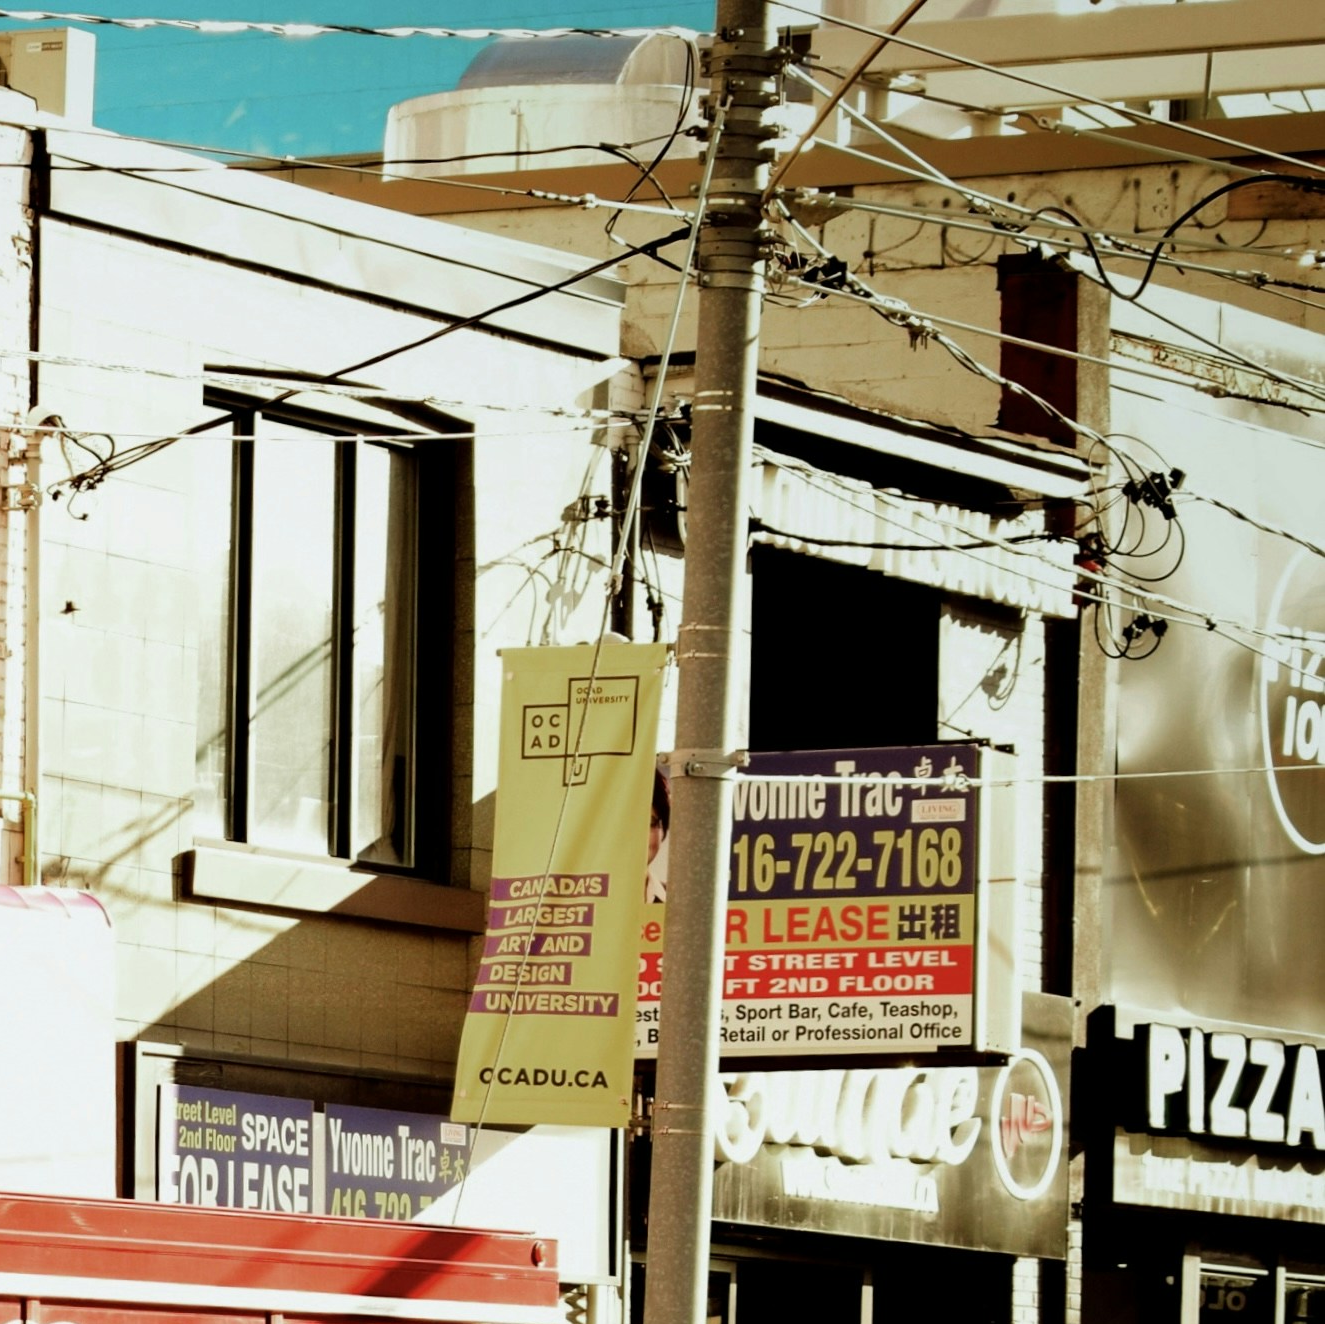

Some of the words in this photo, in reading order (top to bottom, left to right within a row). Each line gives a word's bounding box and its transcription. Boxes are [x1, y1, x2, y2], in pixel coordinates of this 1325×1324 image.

[835, 760, 903, 817] Trac
[729, 828, 963, 892] 16-722-7168
[509, 876, 603, 898] CANADA'S
[504, 906, 588, 926] LARGEST
[762, 904, 891, 945] LEASE
[897, 903, 961, 942] 出租
[497, 935, 536, 954] ART
[540, 935, 585, 953] AND
[489, 964, 566, 982] DESIGN
[748, 953, 858, 972] STREET
[868, 950, 957, 969] LEVEL
[769, 976, 829, 994] 2ND
[838, 973, 935, 993] FLOOR
[484, 992, 614, 1014] UNIVERSITY
[734, 1003, 782, 1025] Sport
[788, 1002, 822, 1022] Bar,
[828, 1000, 874, 1020] Cafe,
[879, 998, 959, 1021] Teashop,
[772, 1028, 790, 1042] or
[795, 1023, 903, 1042] Professional
[910, 1021, 963, 1039] Office
[478, 1067, 609, 1089] OCADU.CA
[1149, 1022, 1325, 1149] PIZZA
[205, 1101, 237, 1126] Level
[178, 1125, 202, 1149] 2nd
[205, 1128, 237, 1153] Floor
[241, 1112, 310, 1157] SPACE
[329, 1117, 395, 1180] Yvonne
[398, 1124, 437, 1183] Trac
